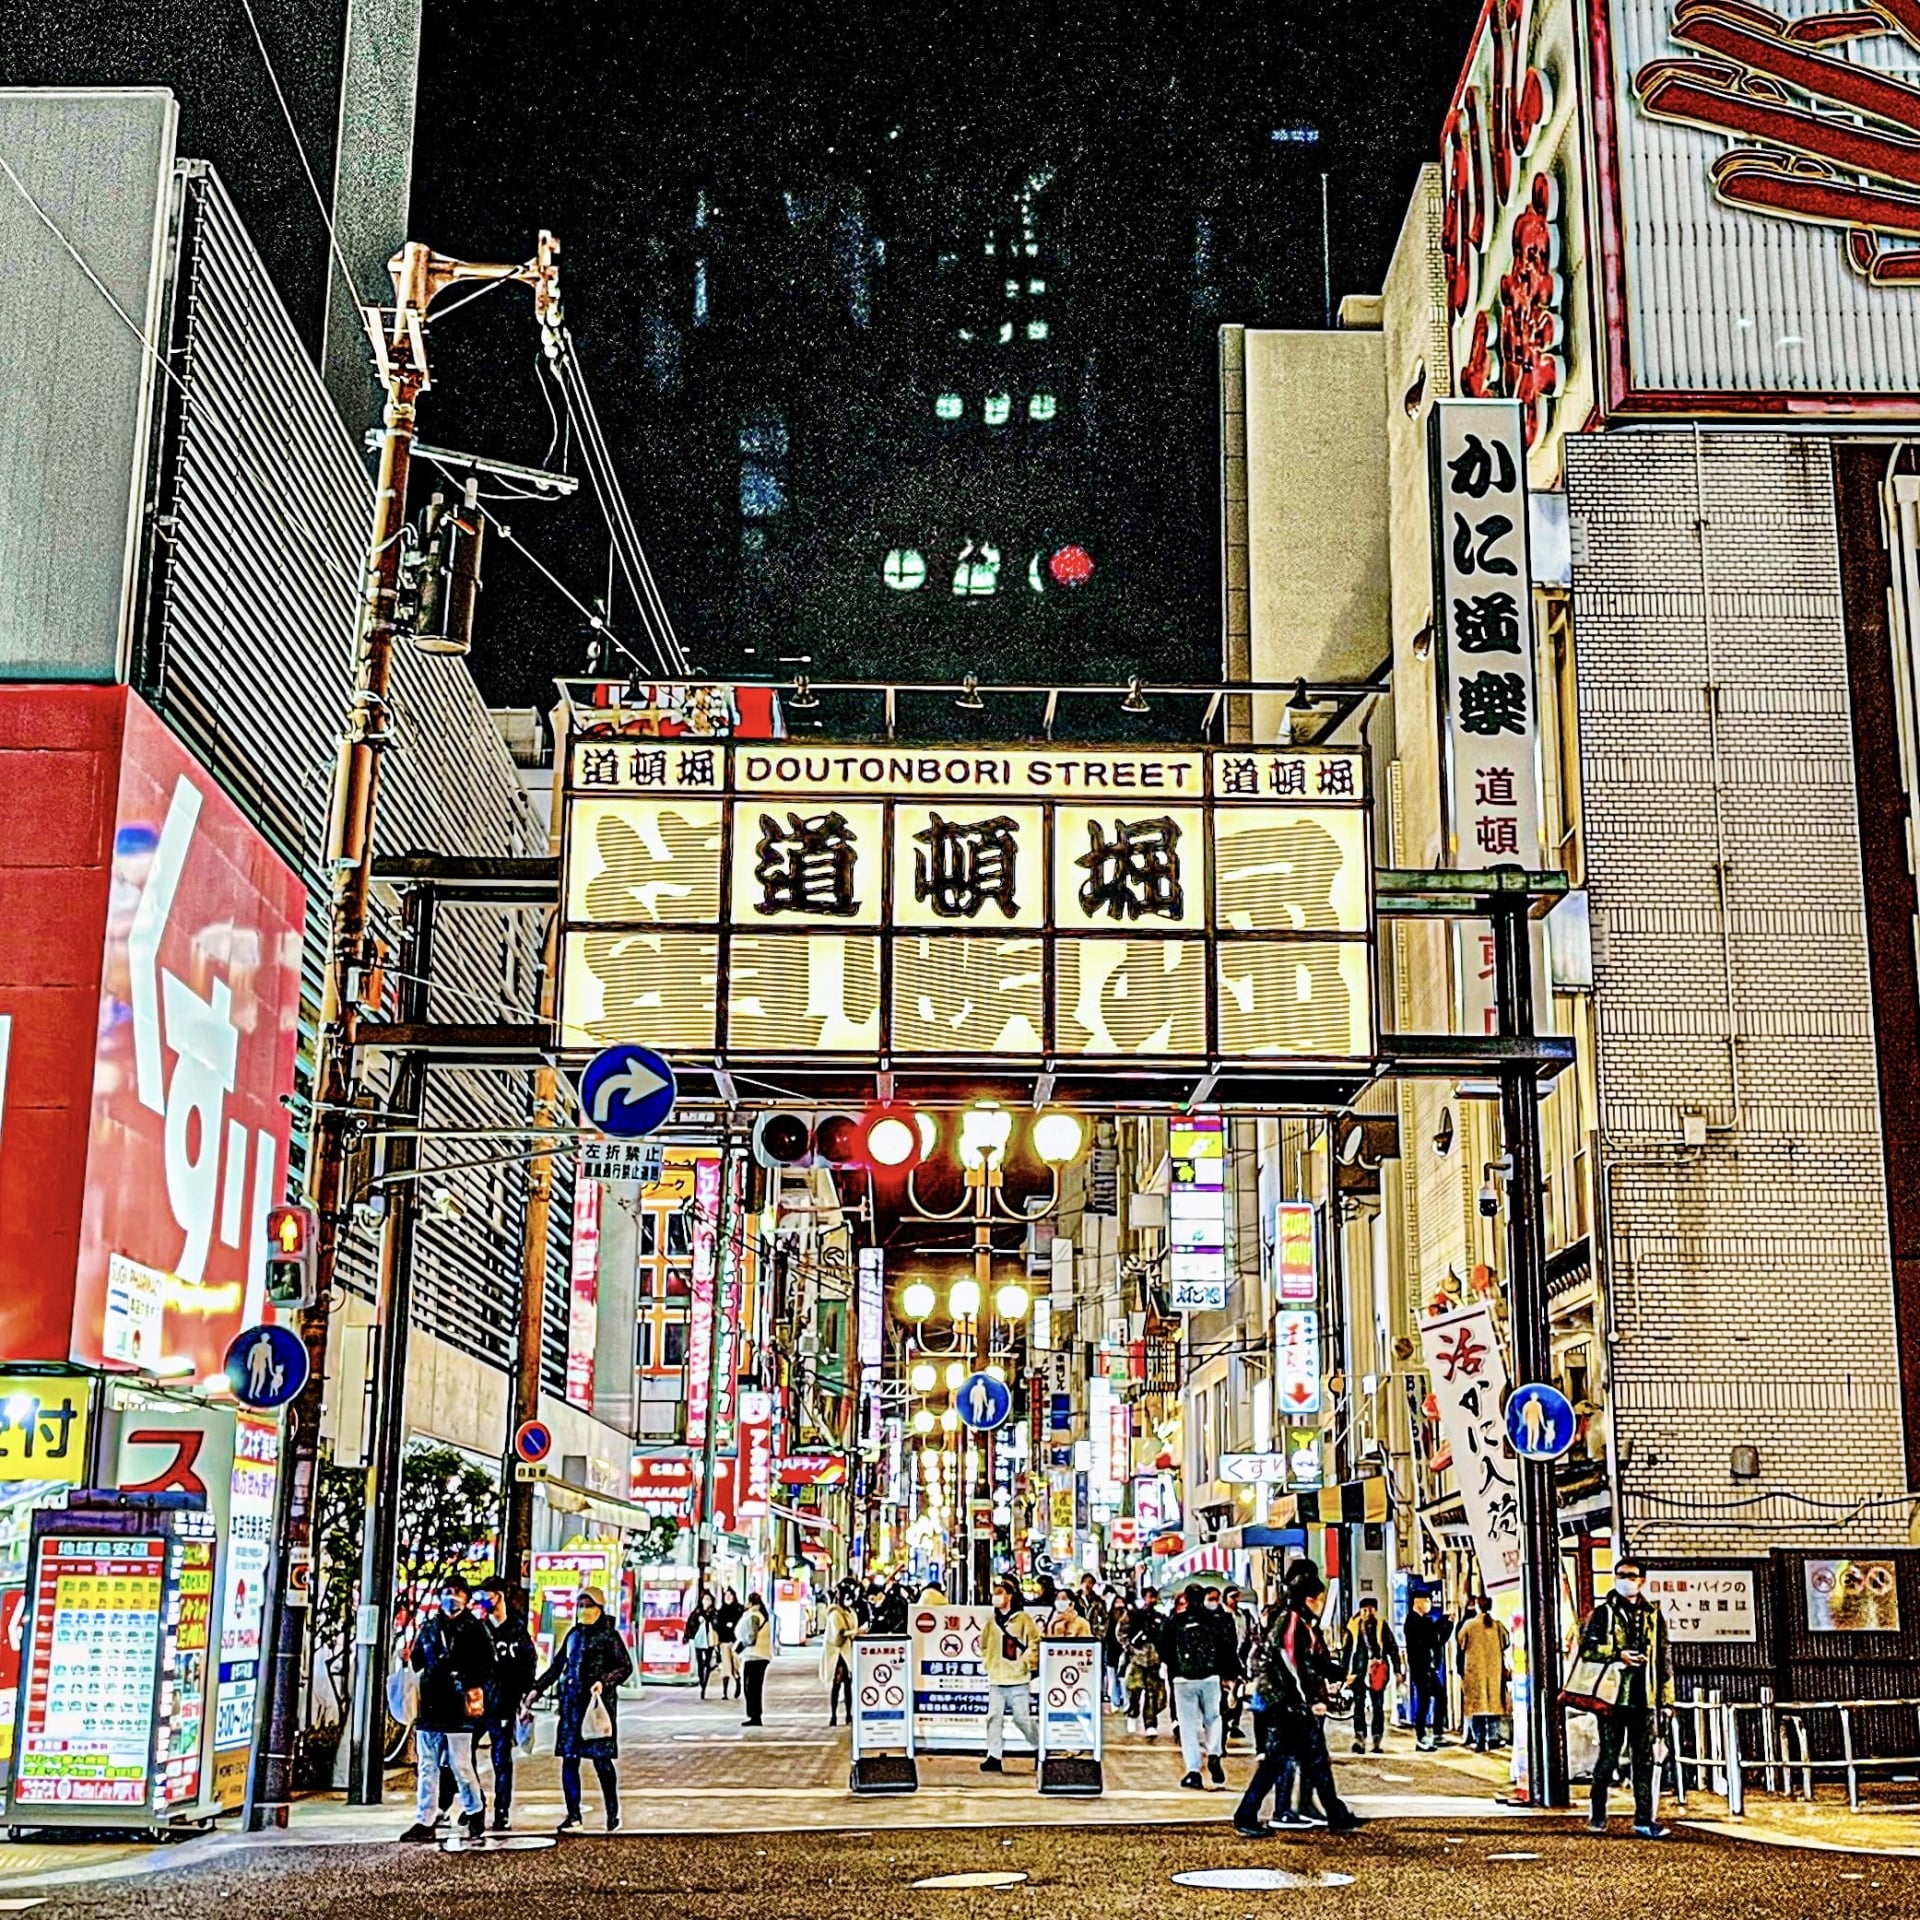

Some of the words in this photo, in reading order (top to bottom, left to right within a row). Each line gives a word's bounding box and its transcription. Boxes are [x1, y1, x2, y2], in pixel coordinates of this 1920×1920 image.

[583, 746, 716, 787] 道頓堀
[747, 757, 1011, 785] DOUTONBORI
[1028, 761, 1192, 788] STREET
[1223, 758, 1355, 796] 道頓堀
[1474, 766, 1519, 868] 道頓
[754, 811, 1184, 921] 道頓堀
[585, 1144, 660, 1162] 左折禁止
[0, 1398, 77, 1457] 付
[1436, 1326, 1518, 1542] 活かに入荷
[1650, 1580, 1746, 1593] 自転車・バイクの
[1651, 1598, 1747, 1611] 入・放置は
